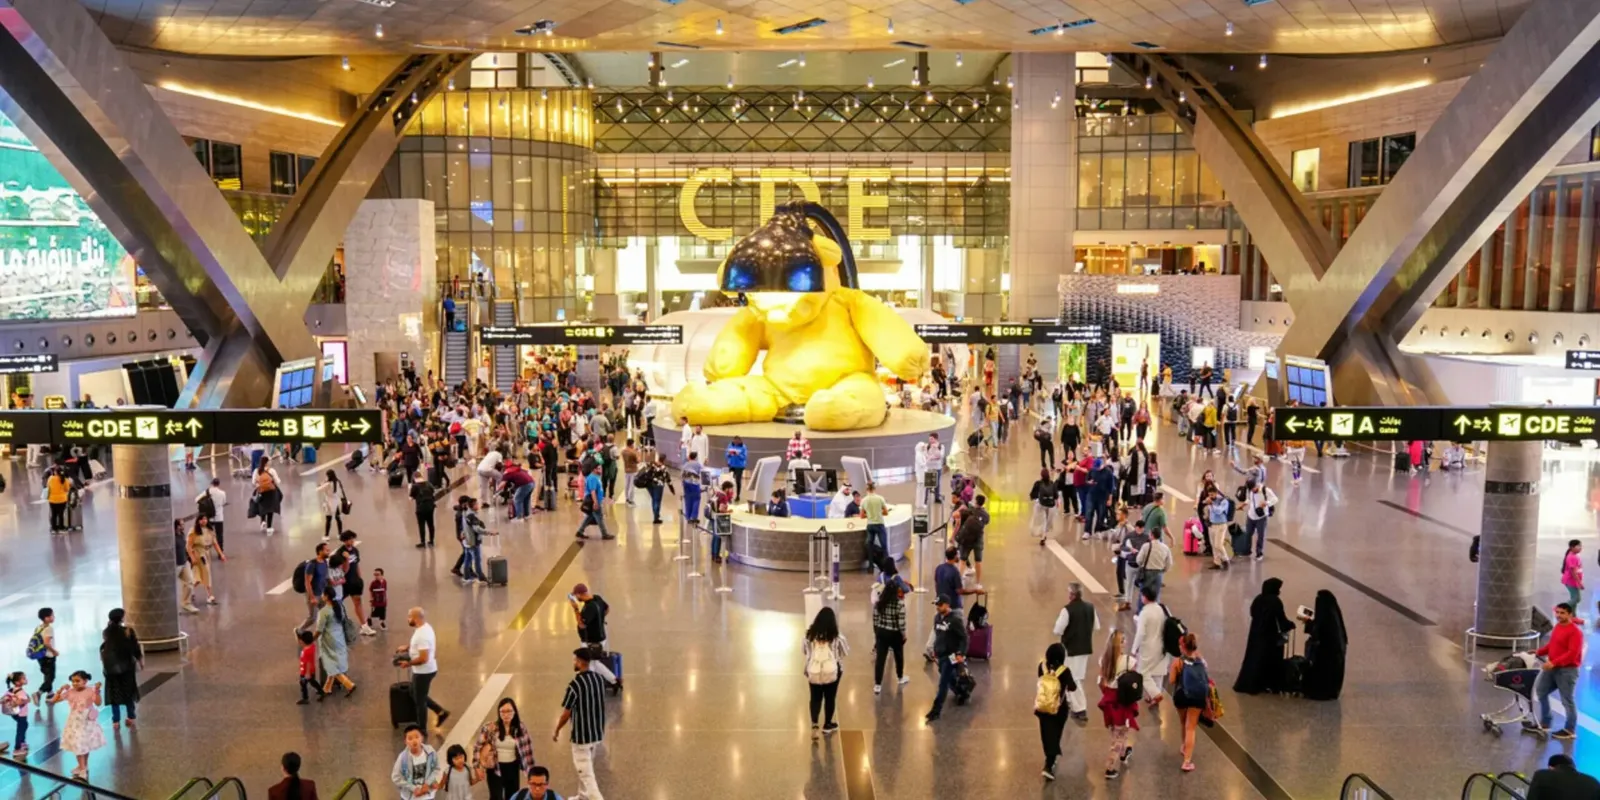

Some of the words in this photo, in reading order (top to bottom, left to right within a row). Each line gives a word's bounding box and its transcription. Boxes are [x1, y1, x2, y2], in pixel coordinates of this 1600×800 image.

[679, 167, 892, 241] CDE
[77, 235, 110, 277] بنك
[575, 327, 595, 337] CDE
[1002, 326, 1023, 336] CDE
[87, 419, 132, 437] CDE
[283, 419, 299, 435] B
[1357, 416, 1376, 434] A
[1525, 415, 1570, 434] CDE
